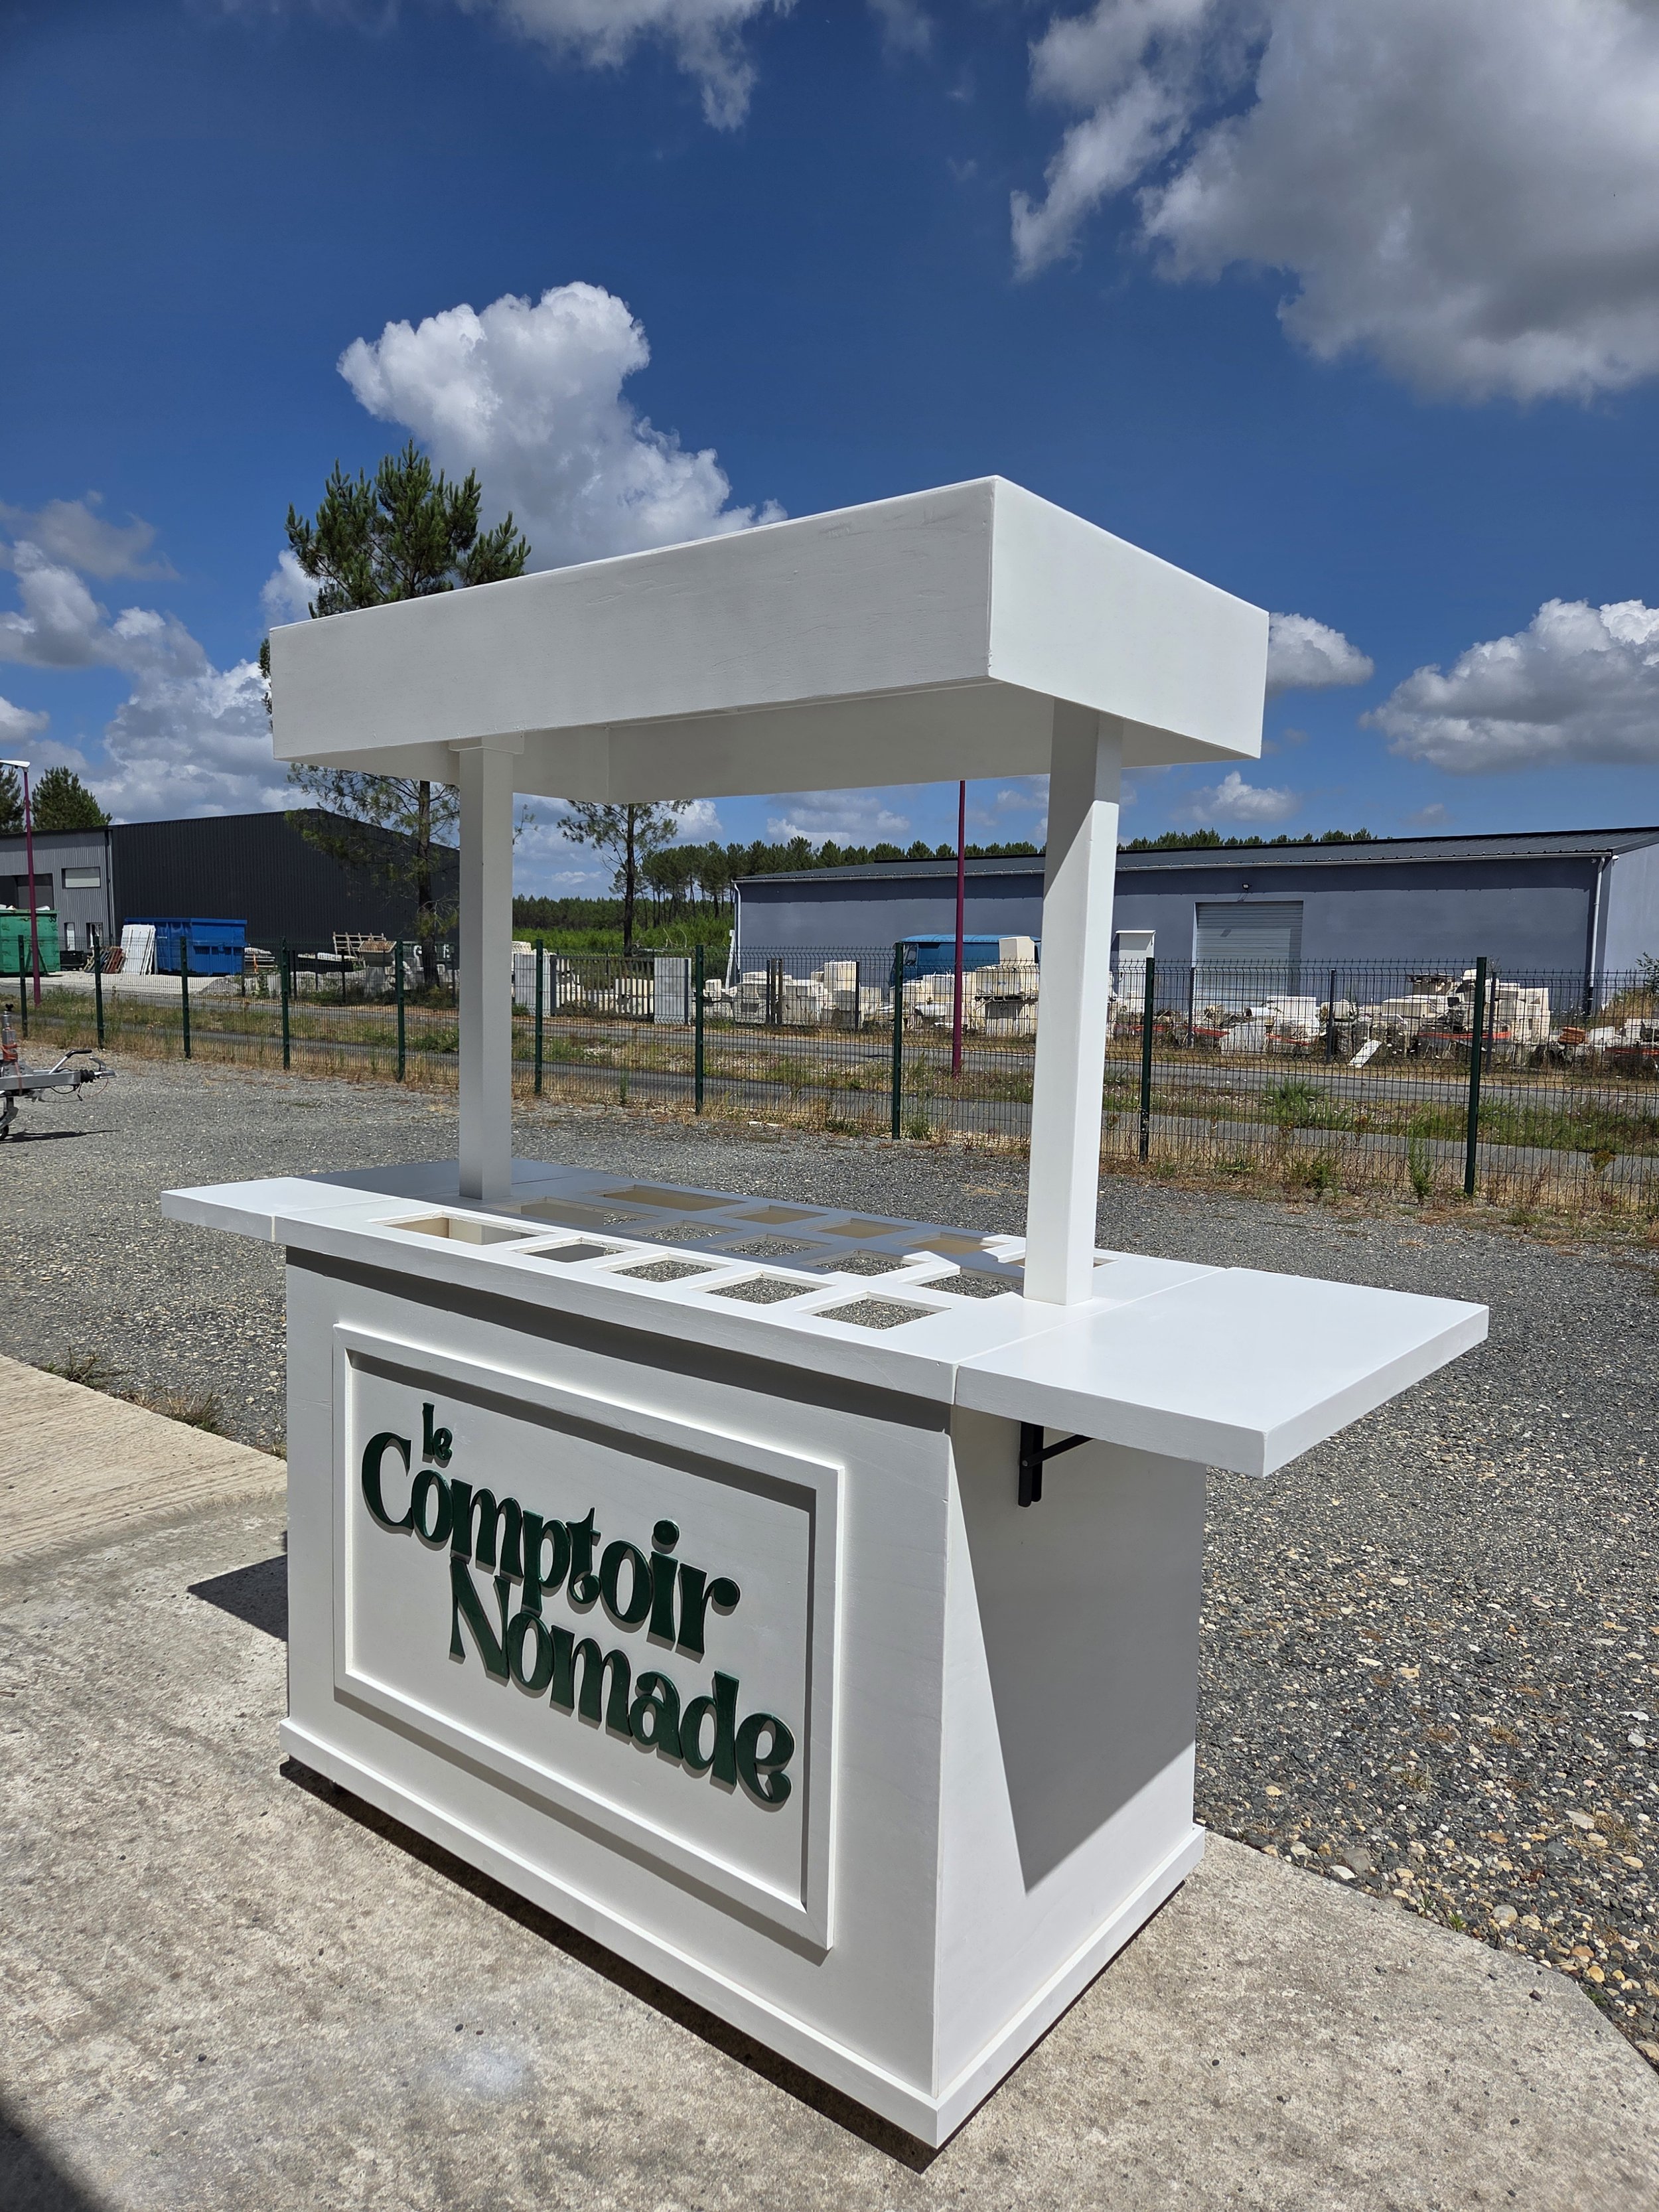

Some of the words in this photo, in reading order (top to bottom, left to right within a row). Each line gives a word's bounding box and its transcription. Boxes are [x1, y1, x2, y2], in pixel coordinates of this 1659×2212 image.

[362, 1432, 741, 1657] Comptoir
[423, 1402, 454, 1463] le
[449, 1557, 796, 1804] Nomade
